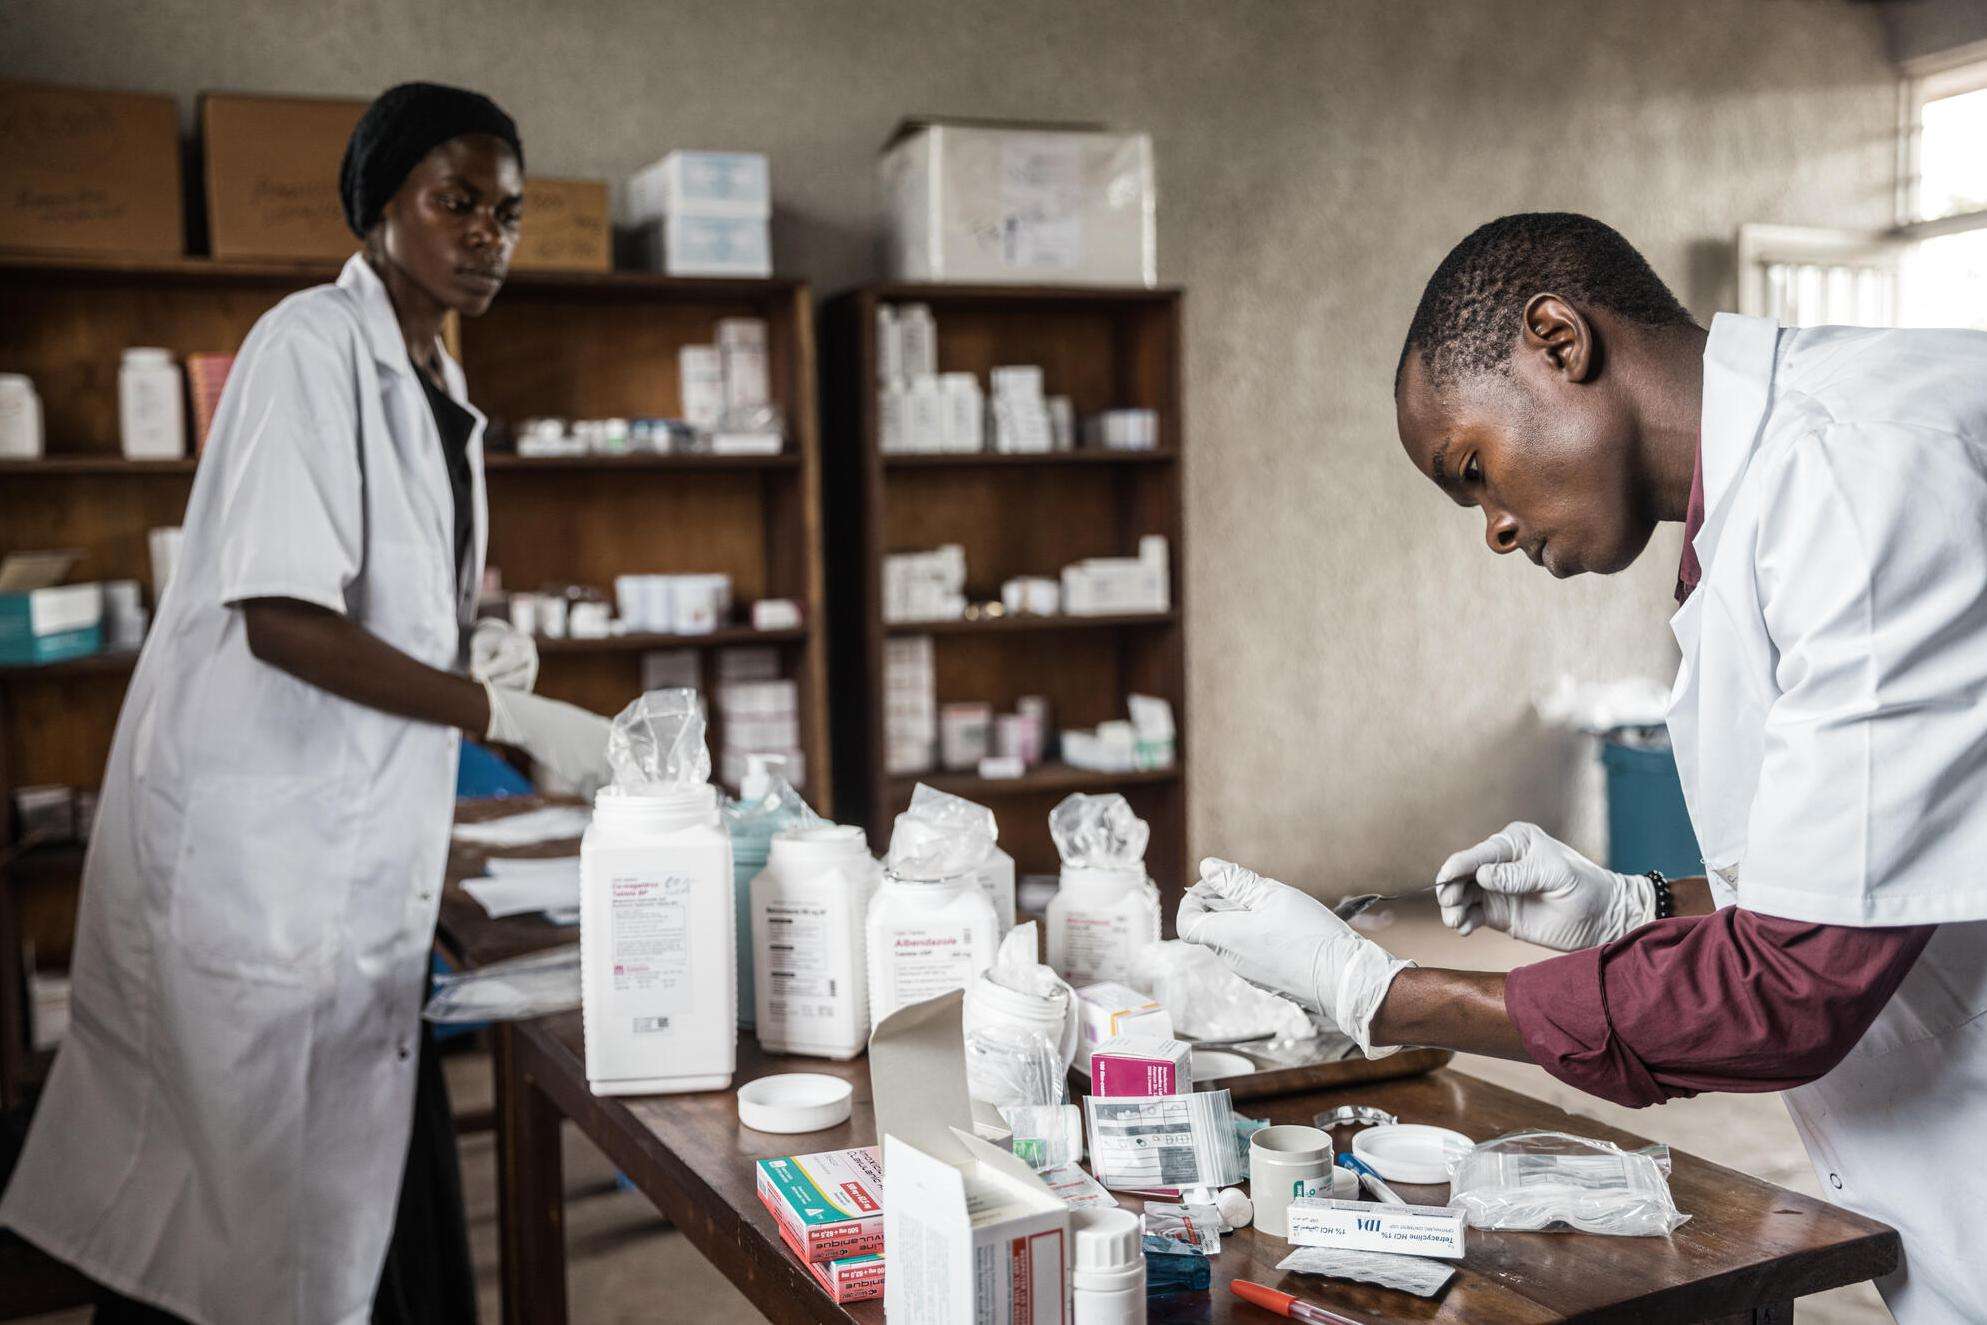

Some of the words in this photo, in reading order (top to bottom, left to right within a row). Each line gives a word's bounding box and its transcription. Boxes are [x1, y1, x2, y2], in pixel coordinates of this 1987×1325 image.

[1357, 1218, 1381, 1232] IDA
[1381, 1231, 1392, 1239] 1%
[1394, 1232, 1408, 1240] HCl
[1409, 1233, 1454, 1244] Tetracycline
